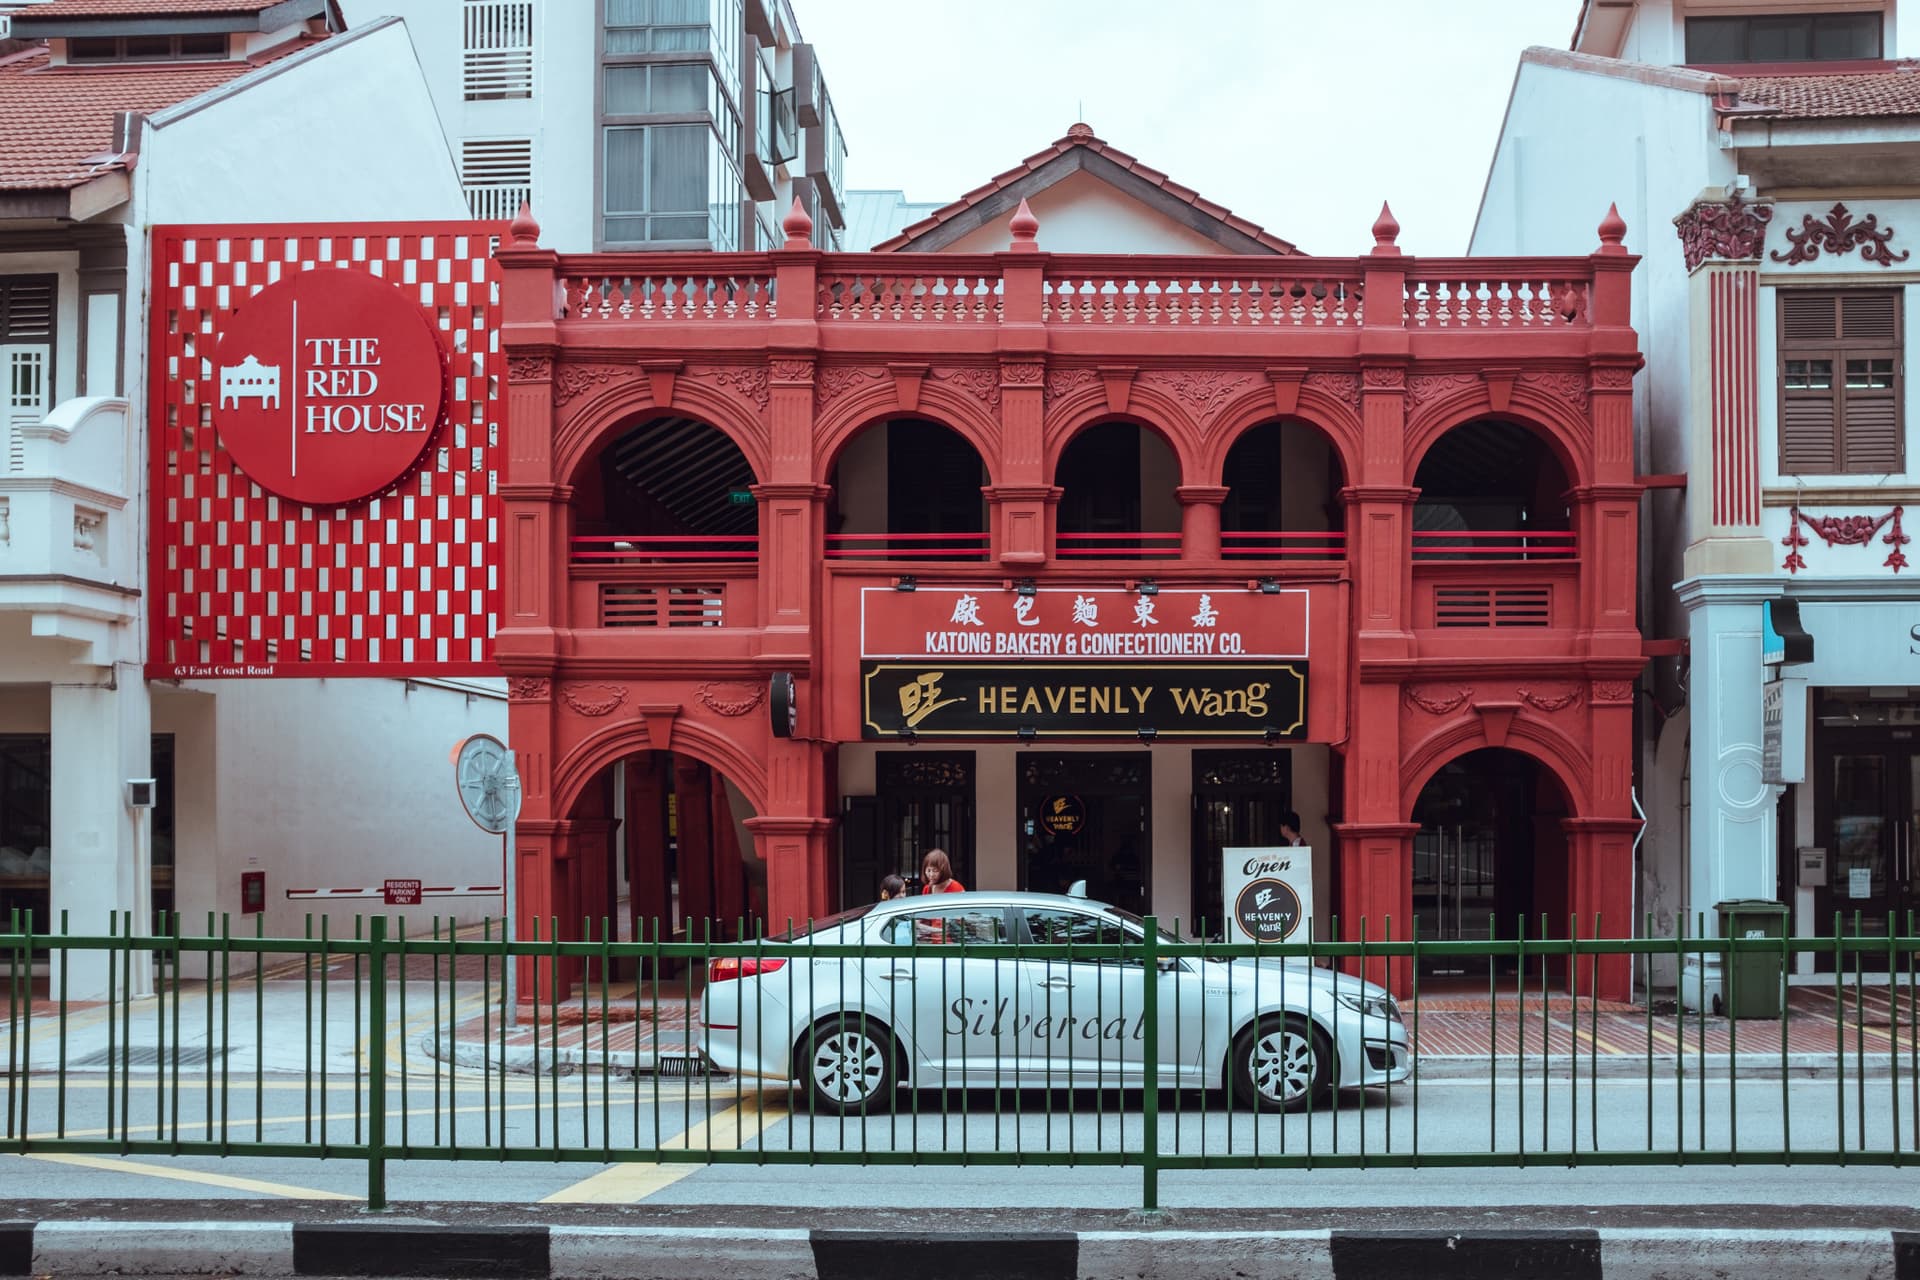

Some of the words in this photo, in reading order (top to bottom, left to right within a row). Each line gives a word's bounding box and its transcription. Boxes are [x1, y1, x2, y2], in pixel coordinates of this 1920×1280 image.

[305, 338, 381, 366] THE
[305, 369, 378, 397] RED
[305, 403, 427, 433] HOUSE
[925, 632, 991, 653] KATONG
[995, 633, 1062, 654] BAKERY
[1065, 633, 1077, 654] &
[1081, 633, 1215, 655] CONFECTIONERY
[1219, 633, 1246, 654] CO.
[174, 666, 186, 676] 63
[189, 666, 212, 676] East
[214, 665, 244, 676] Coast
[247, 665, 273, 676] Road
[979, 686, 1153, 714] HEAVENLY
[1169, 682, 1271, 717] Wang
[1243, 857, 1291, 878] Open
[386, 881, 420, 889] RESIDENTS
[389, 888, 416, 897] PARKING
[395, 896, 412, 904] ONLY
